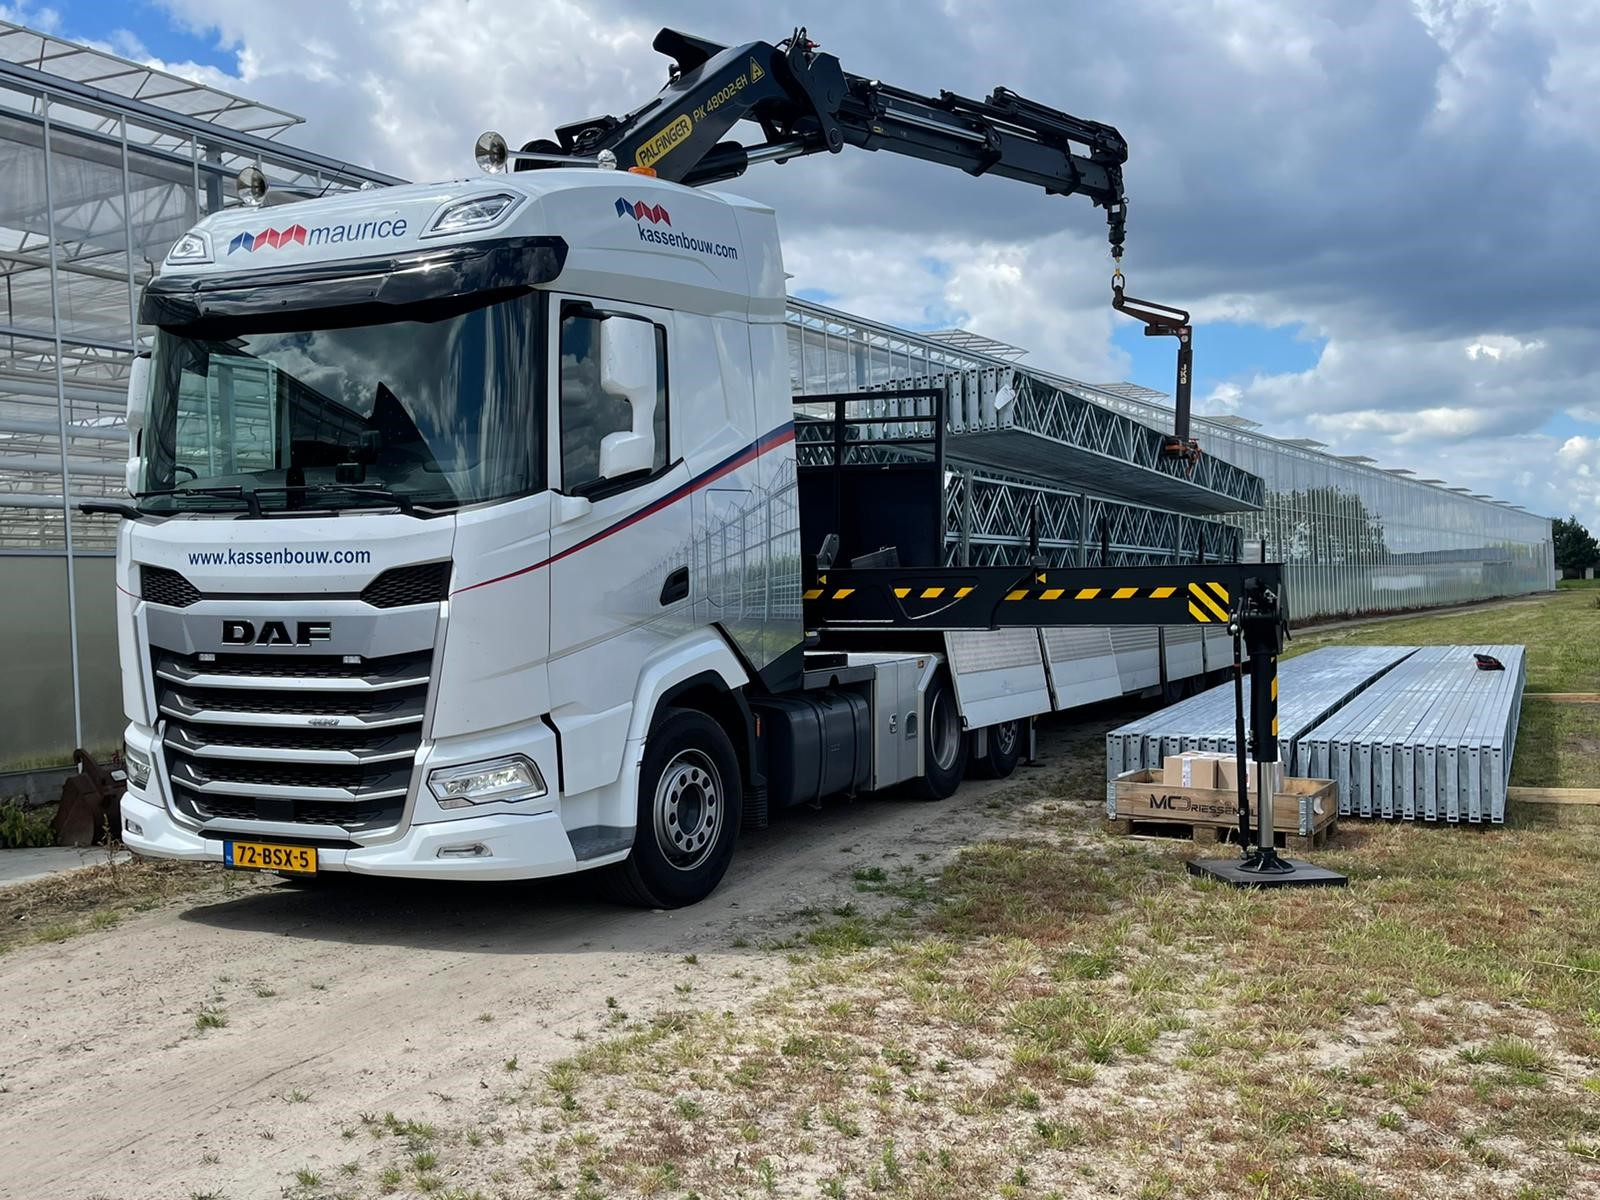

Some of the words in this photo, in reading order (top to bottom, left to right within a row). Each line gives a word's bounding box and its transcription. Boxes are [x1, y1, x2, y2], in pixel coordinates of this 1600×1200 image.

[692, 104, 707, 123] PK
[706, 74, 749, 113] 48002-EH
[638, 119, 691, 166] PALFINGER
[308, 218, 408, 246] maurice
[637, 223, 738, 260] kassenbouw.com
[188, 547, 371, 565] www.kassenbouw.com
[221, 619, 331, 648] DAF
[237, 845, 309, 868] 72-BSX-5
